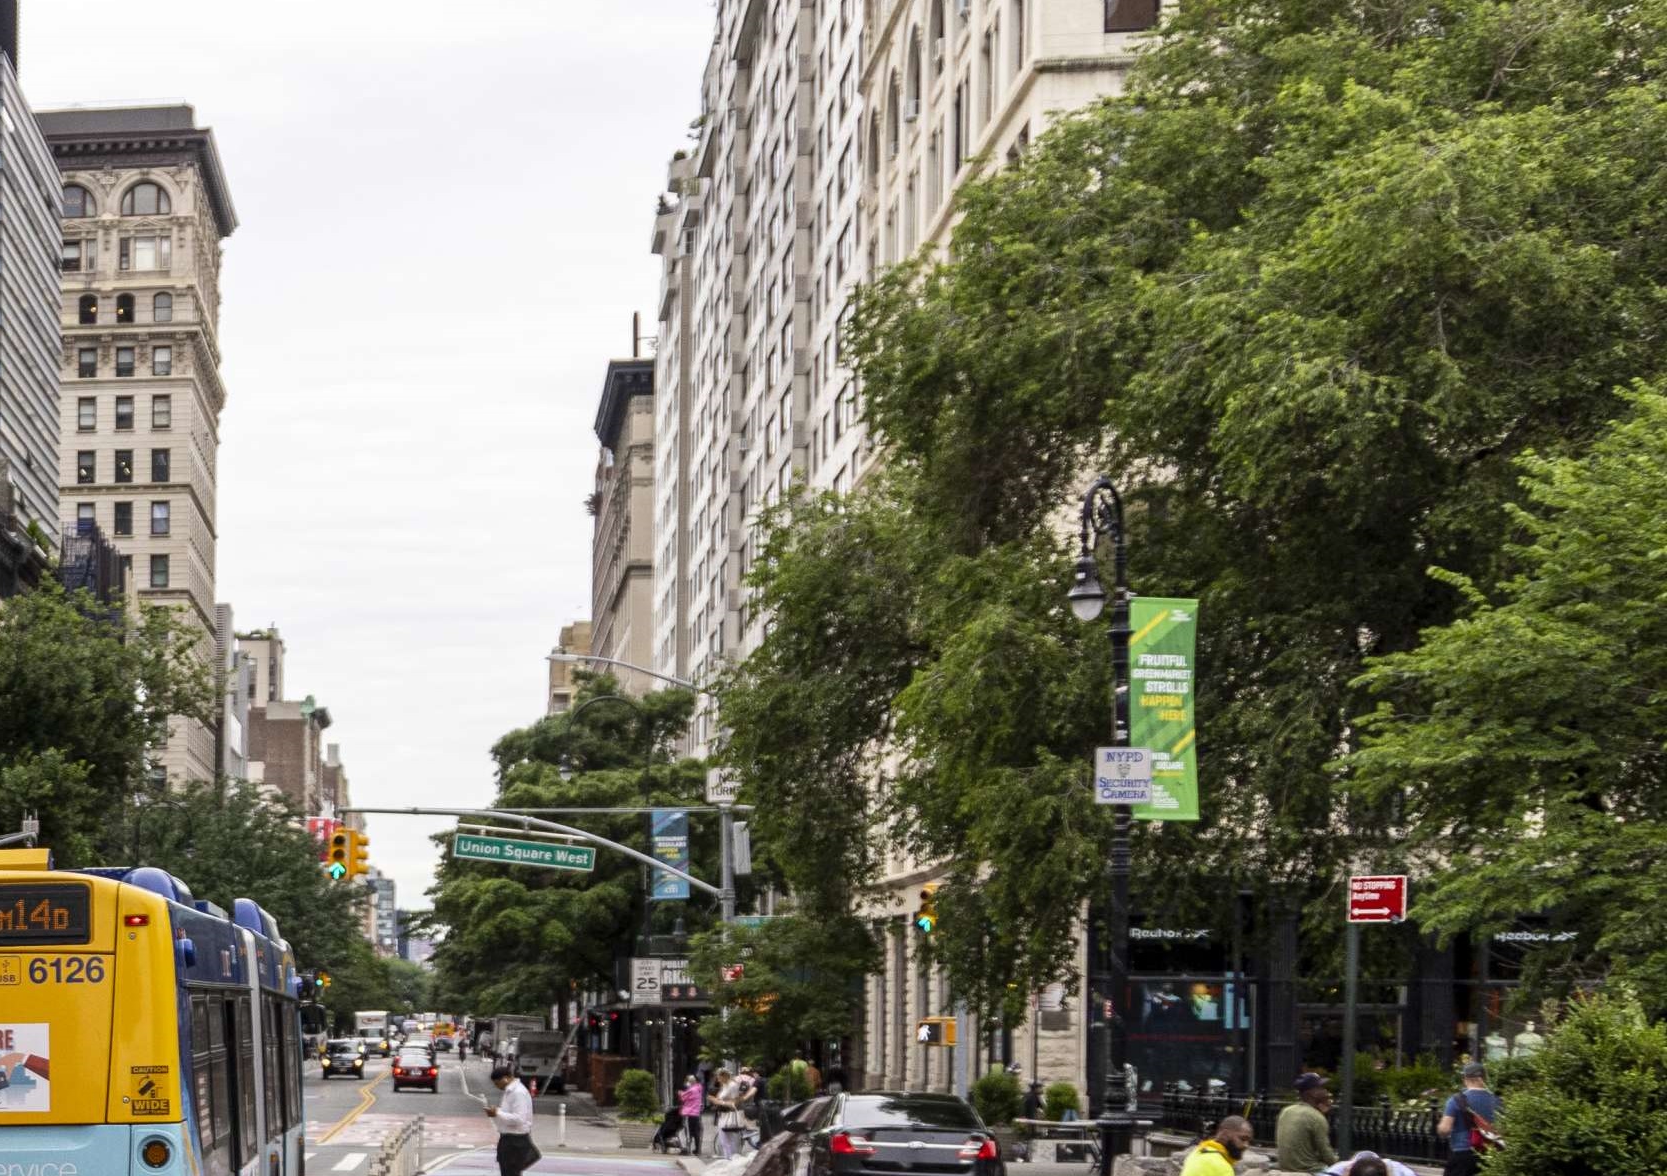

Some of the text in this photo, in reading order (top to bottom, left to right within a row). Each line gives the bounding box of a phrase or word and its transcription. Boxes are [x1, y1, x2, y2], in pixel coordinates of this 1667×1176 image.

[1106, 752, 1144, 763] NYPD
[460, 840, 589, 865] Union Square West
[28, 956, 105, 984] 6126
[636, 977, 659, 990] 25
[133, 1100, 169, 1110] WIDE
